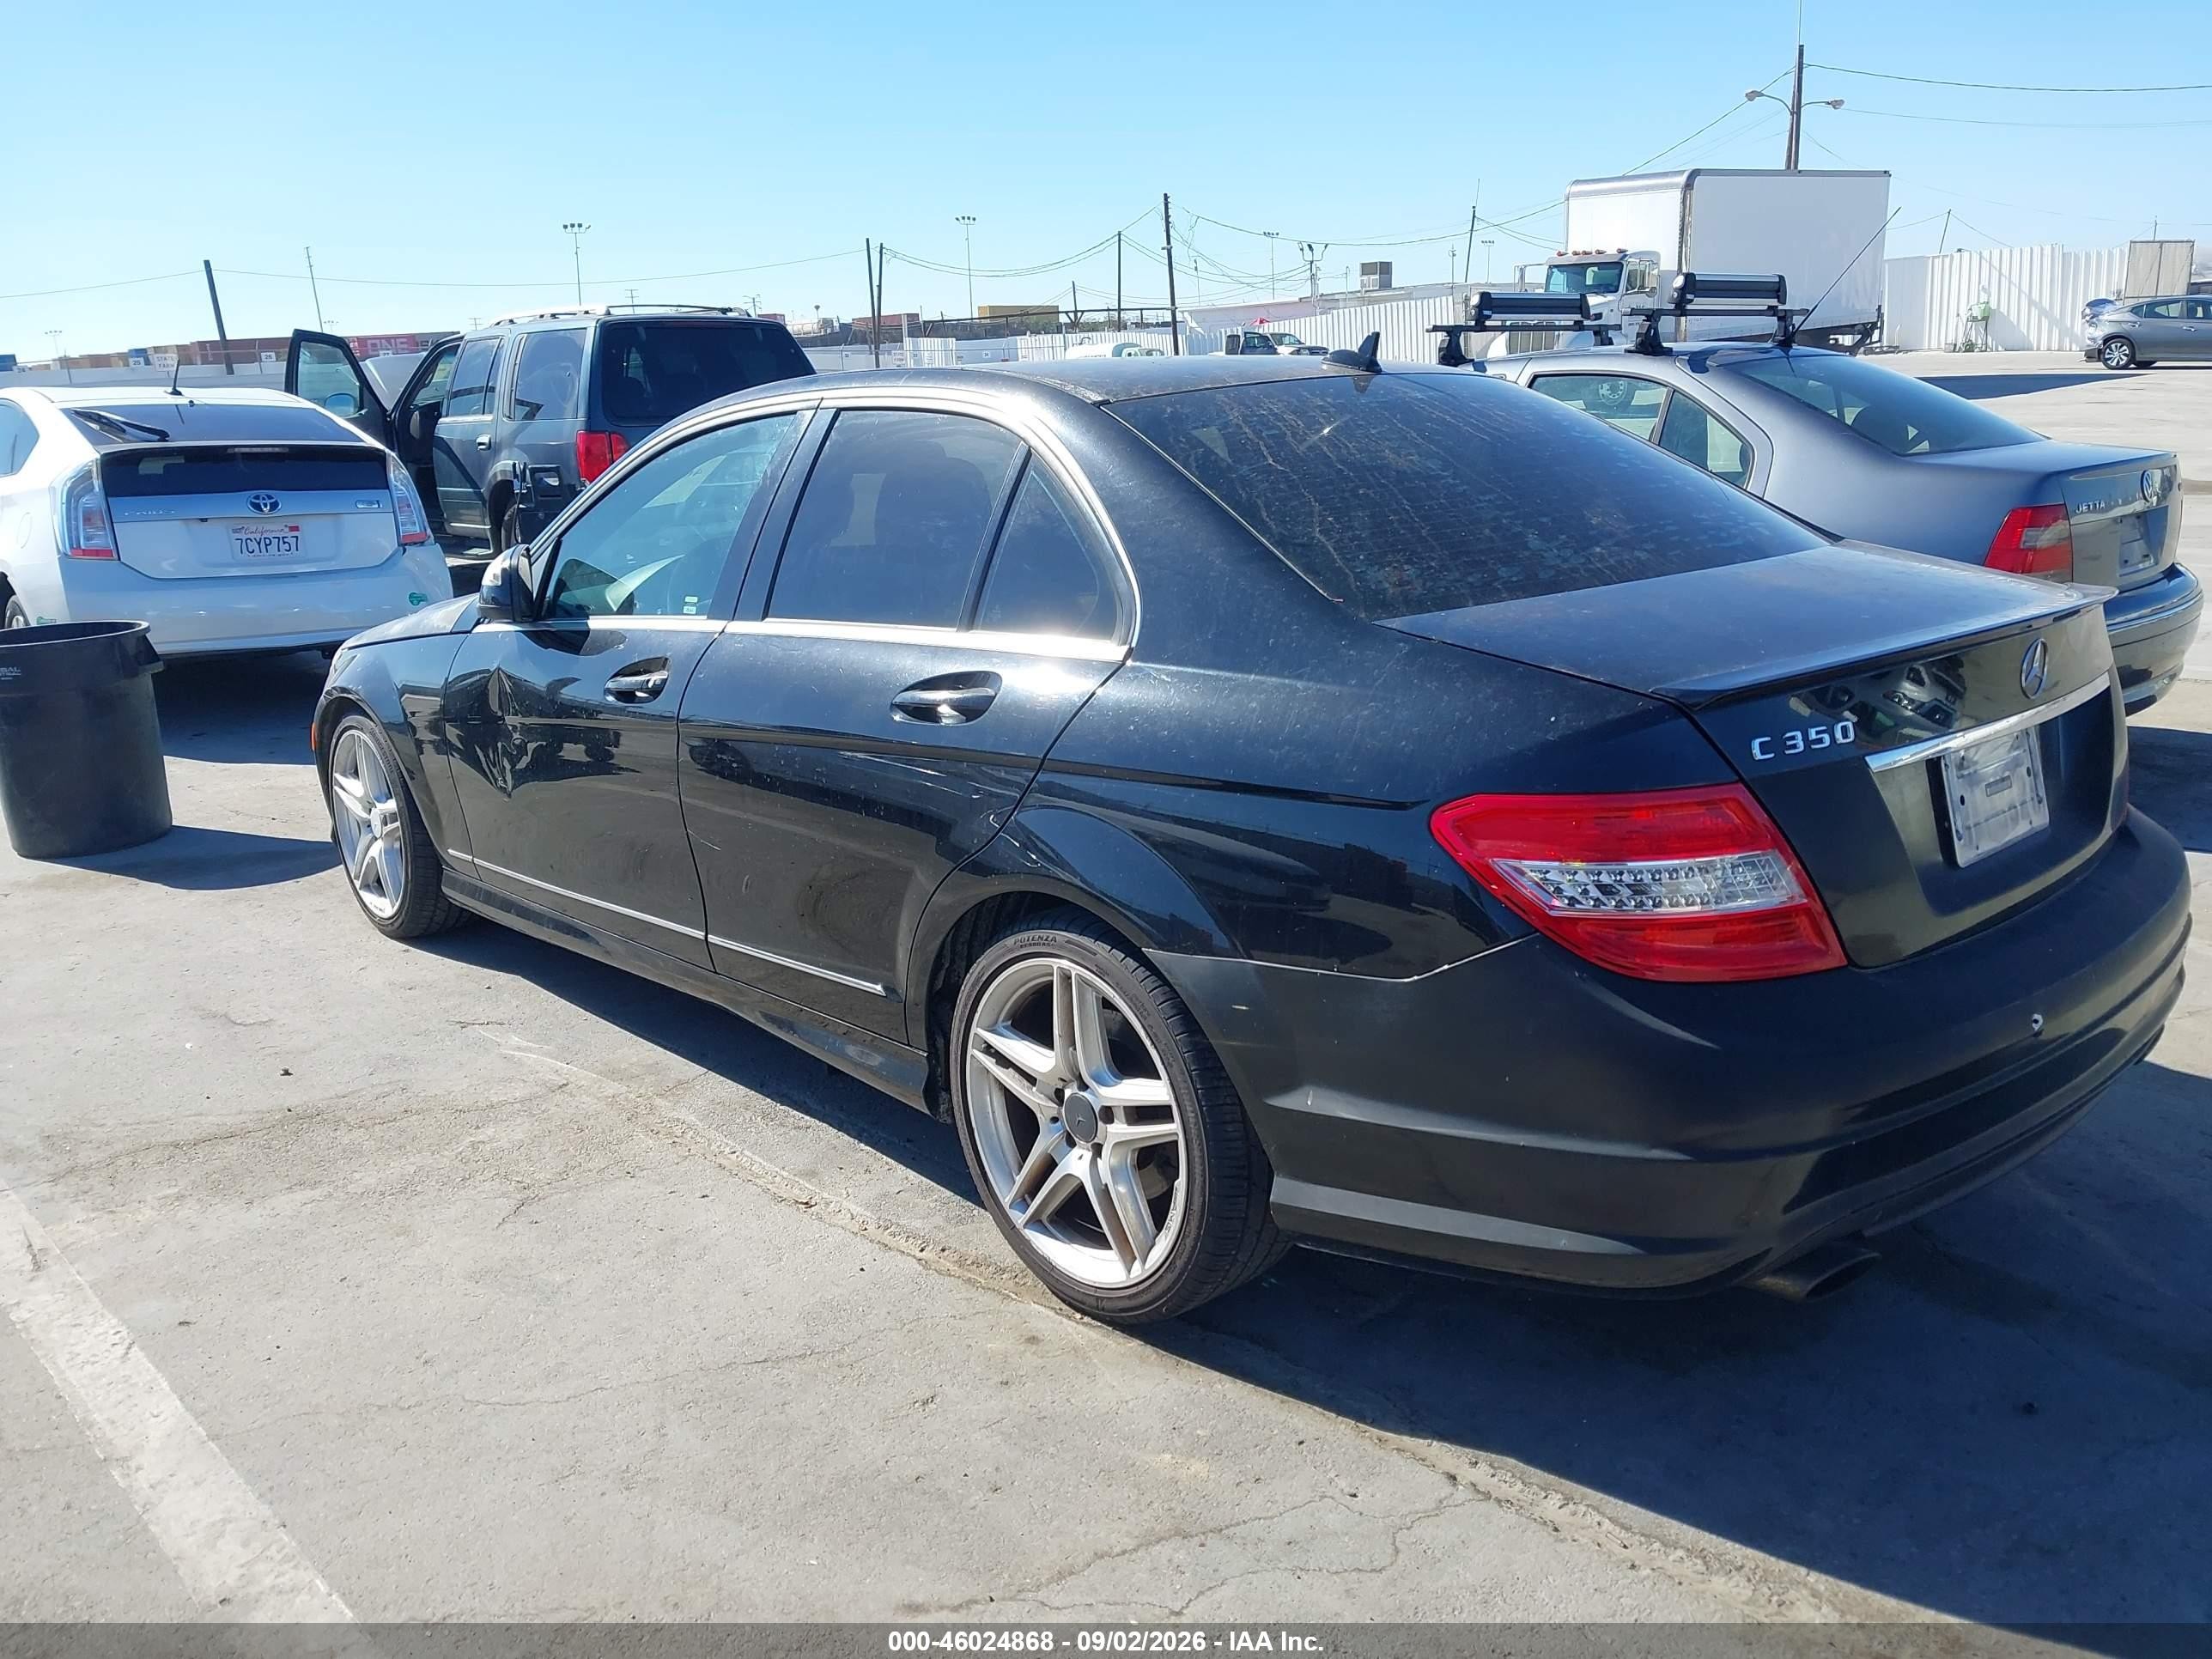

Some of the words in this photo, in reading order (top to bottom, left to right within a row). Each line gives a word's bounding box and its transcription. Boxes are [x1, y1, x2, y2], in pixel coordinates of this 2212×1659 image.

[2075, 499, 2106, 514] JETTA
[234, 535, 299, 555] 7CYP757
[1751, 736, 1775, 761] C
[1782, 720, 1856, 755] 350
[1013, 934, 1057, 945] POTENZA
